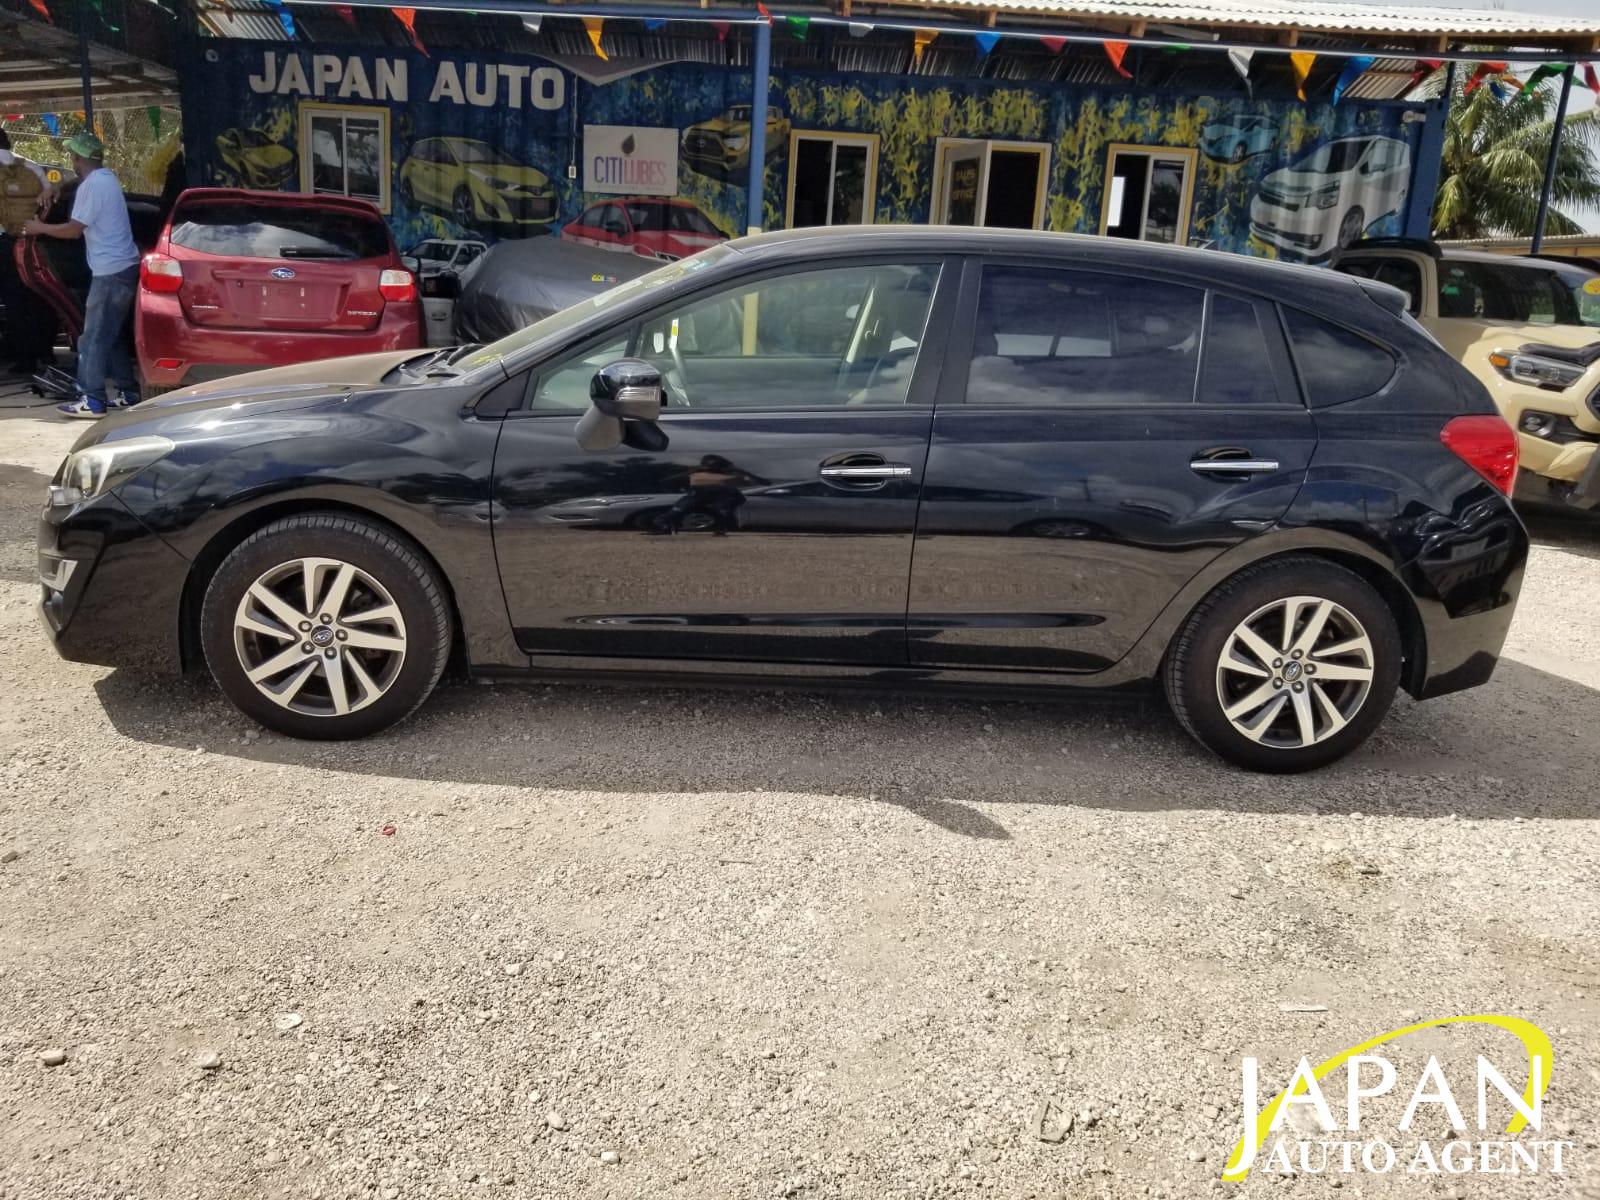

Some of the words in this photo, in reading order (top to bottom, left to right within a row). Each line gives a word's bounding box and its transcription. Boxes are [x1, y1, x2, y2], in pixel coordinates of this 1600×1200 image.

[248, 51, 409, 102] JAPAN
[429, 61, 565, 111] AUTO
[594, 155, 667, 186] CITILUBES
